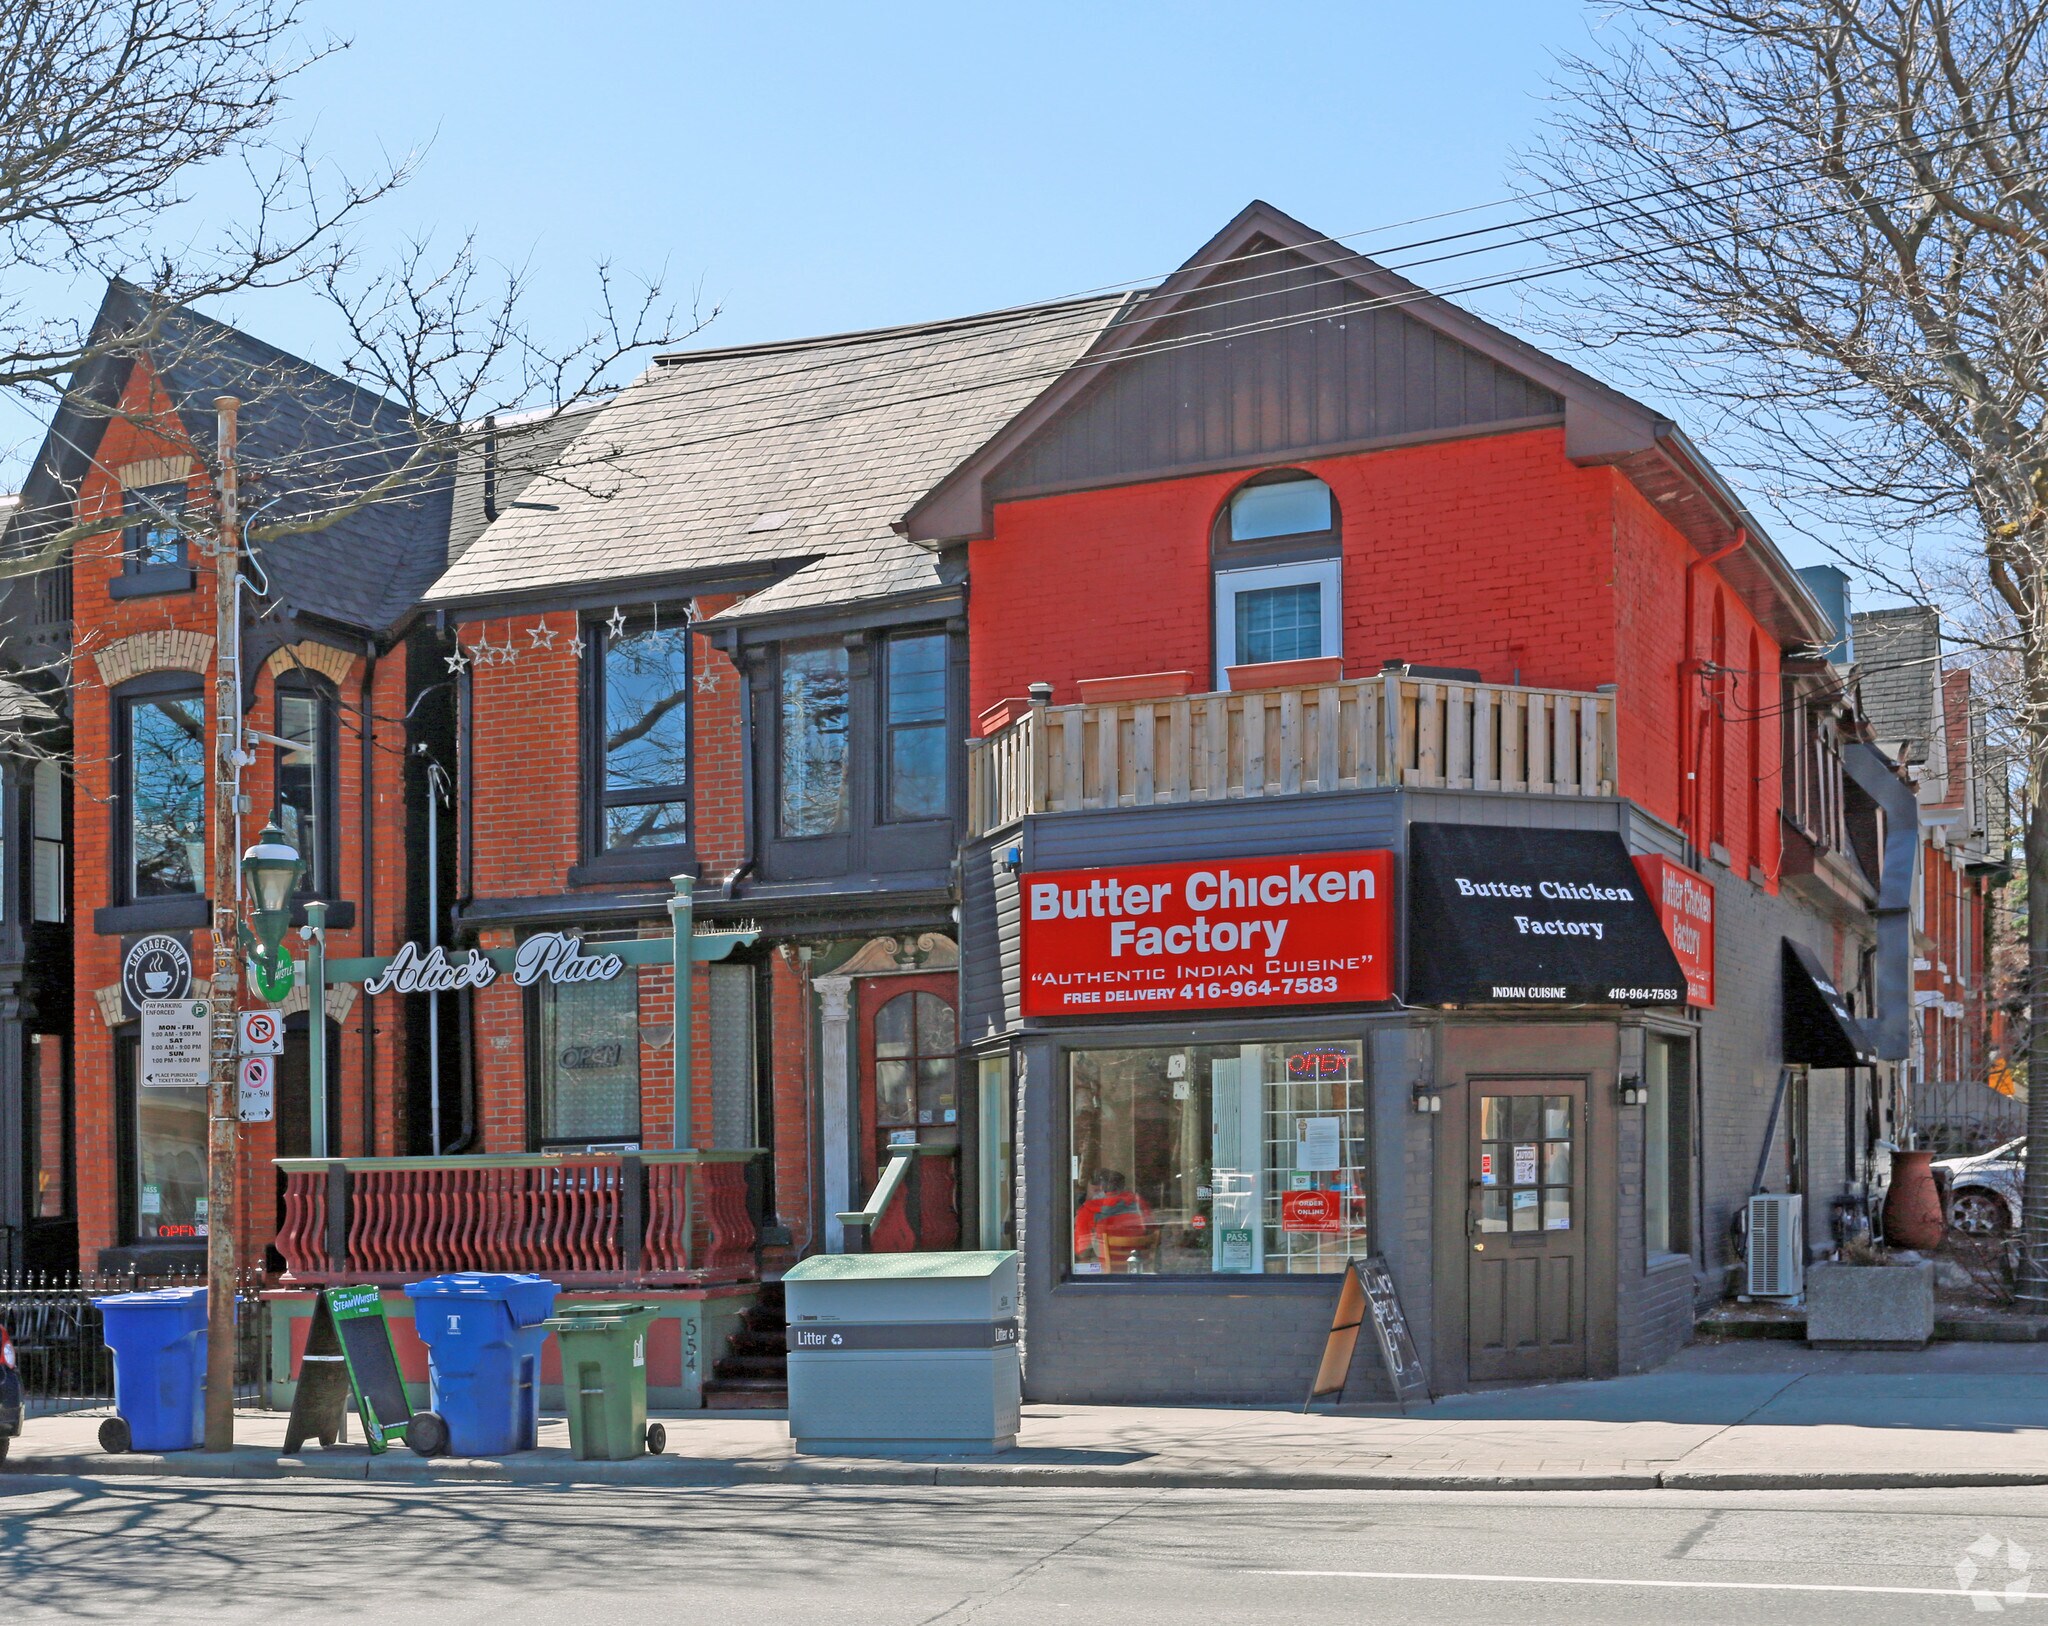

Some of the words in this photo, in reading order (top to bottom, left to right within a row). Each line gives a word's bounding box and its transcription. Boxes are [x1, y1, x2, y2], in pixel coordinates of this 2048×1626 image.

[1030, 878, 1172, 921] Butter
[1185, 865, 1375, 911] Chicken
[1454, 878, 1532, 898] Butter
[1538, 881, 1634, 901] Chicken
[1110, 916, 1288, 957] Factory
[1513, 915, 1603, 940] Factory
[1673, 913, 1701, 964] Factory
[129, 938, 187, 967] CABBAGETOWN
[365, 944, 491, 990] Alice's
[513, 935, 619, 985] Place
[1176, 963, 1253, 979] INDIAN
[1063, 992, 1100, 1005] FREE
[1104, 987, 1176, 1003] DELIVERY
[1179, 976, 1338, 999] 416-964-7583
[1492, 986, 1526, 998] INDIAN
[1528, 987, 1567, 998] CUISINE
[1608, 988, 1678, 1000] 416-964-7583
[560, 1045, 621, 1068] OPEN
[1288, 1053, 1349, 1072] OPEN
[159, 1225, 197, 1237] OPEN
[1226, 1233, 1248, 1241] PASS
[797, 1331, 827, 1345] Litter
[995, 1328, 1008, 1341] Litter
